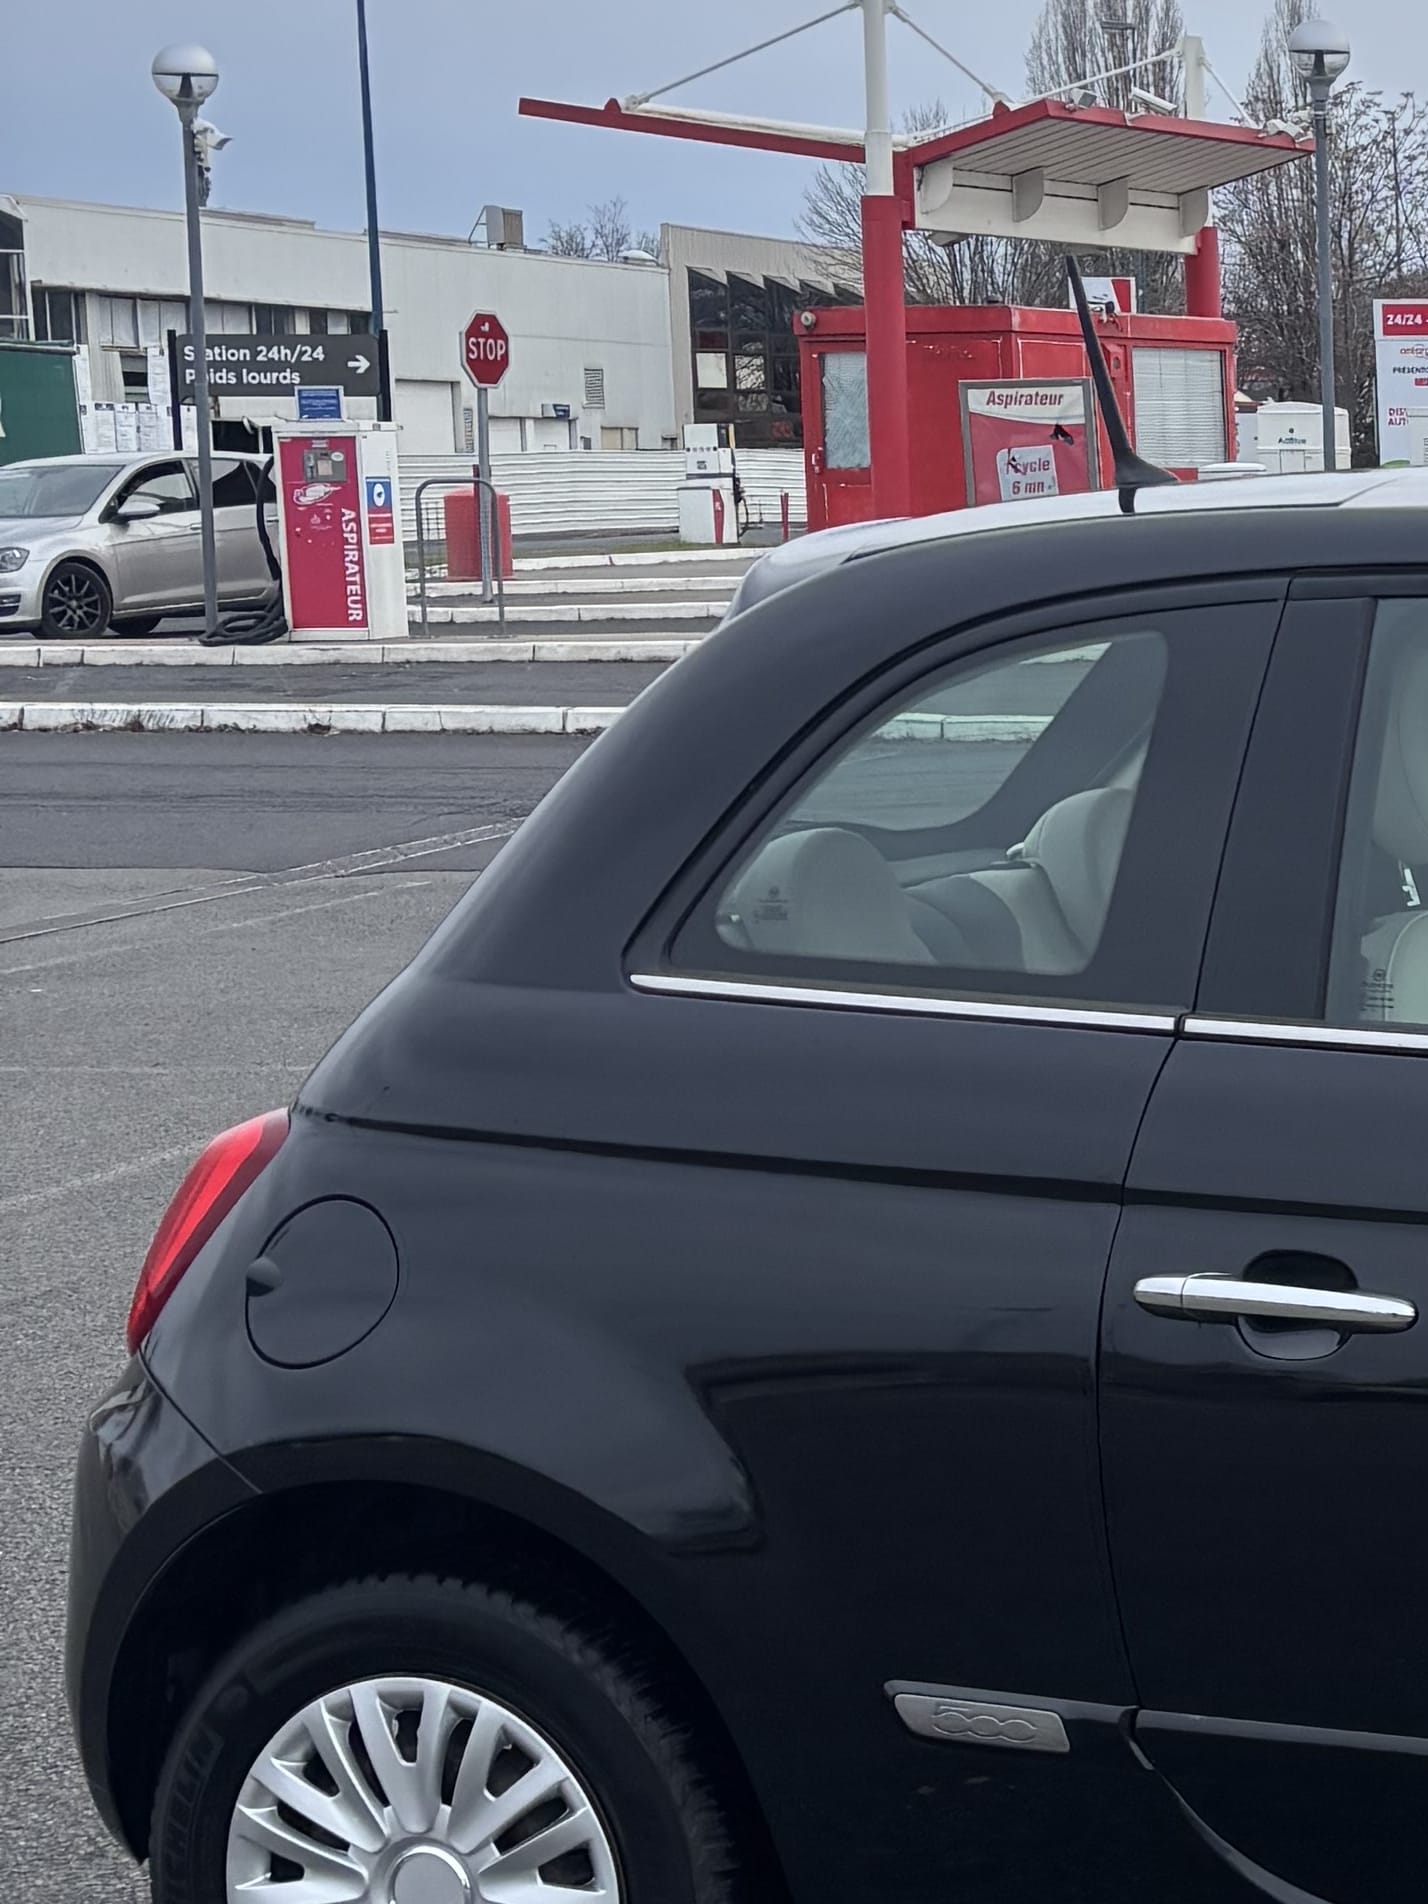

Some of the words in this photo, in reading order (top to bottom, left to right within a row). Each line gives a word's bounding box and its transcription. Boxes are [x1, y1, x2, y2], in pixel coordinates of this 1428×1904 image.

[184, 345, 250, 361] Sation
[256, 343, 325, 363] 24h/24
[468, 337, 506, 361] STOP
[185, 368, 237, 384] Pids
[242, 368, 301, 384] lourds
[986, 390, 1064, 409] Aspirateur
[1012, 480, 1022, 495] 6
[1024, 481, 1045, 494] mn
[341, 507, 363, 621] ASPIRATEUR
[931, 1704, 1038, 1744] 500
